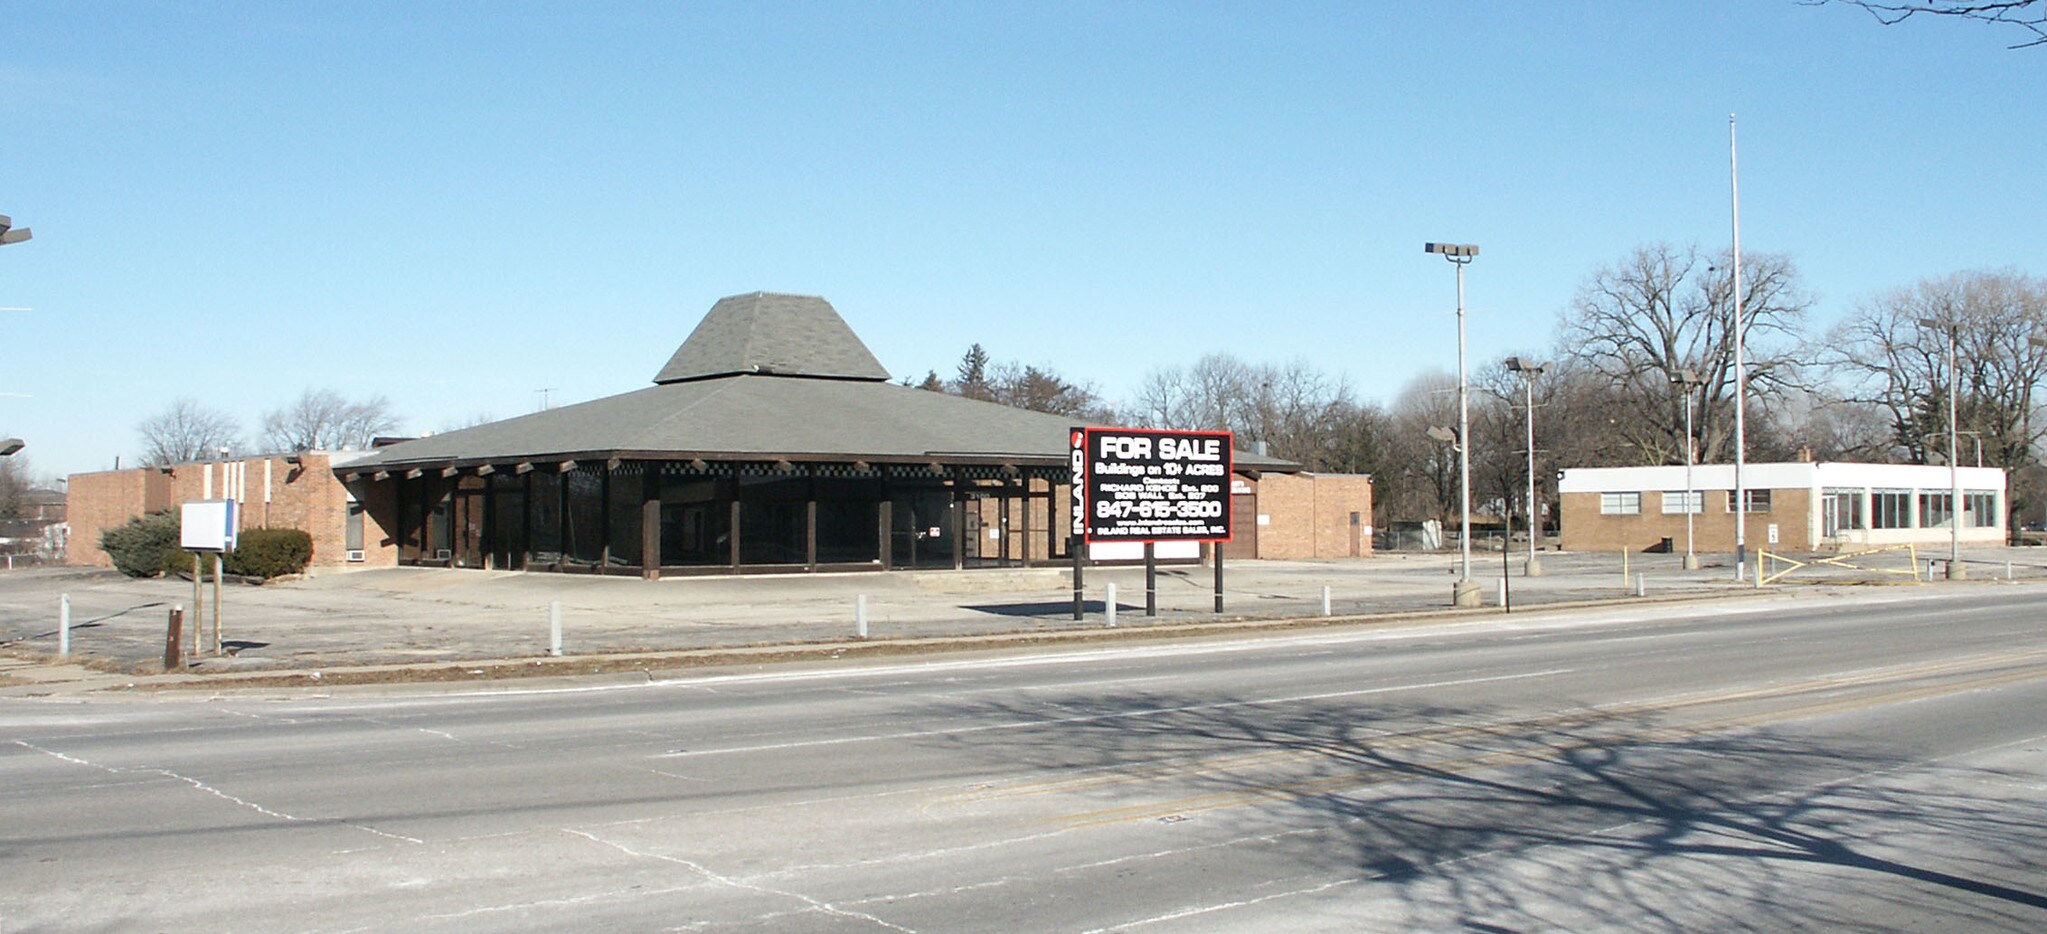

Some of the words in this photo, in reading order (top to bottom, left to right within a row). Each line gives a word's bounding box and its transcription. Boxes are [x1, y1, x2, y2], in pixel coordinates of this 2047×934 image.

[1101, 437, 1151, 459] FOR
[1159, 438, 1220, 461] SALE
[1095, 462, 1145, 477] Buildings
[1147, 466, 1161, 475] on
[1163, 463, 1183, 475] 10+
[1185, 464, 1224, 476] ACRES
[1072, 450, 1084, 534] INLAND
[1100, 484, 1144, 492] RICHARD
[1138, 491, 1165, 499] WALL
[1097, 501, 1221, 518] 847-615-3500
[1097, 527, 1128, 535] INLAND
